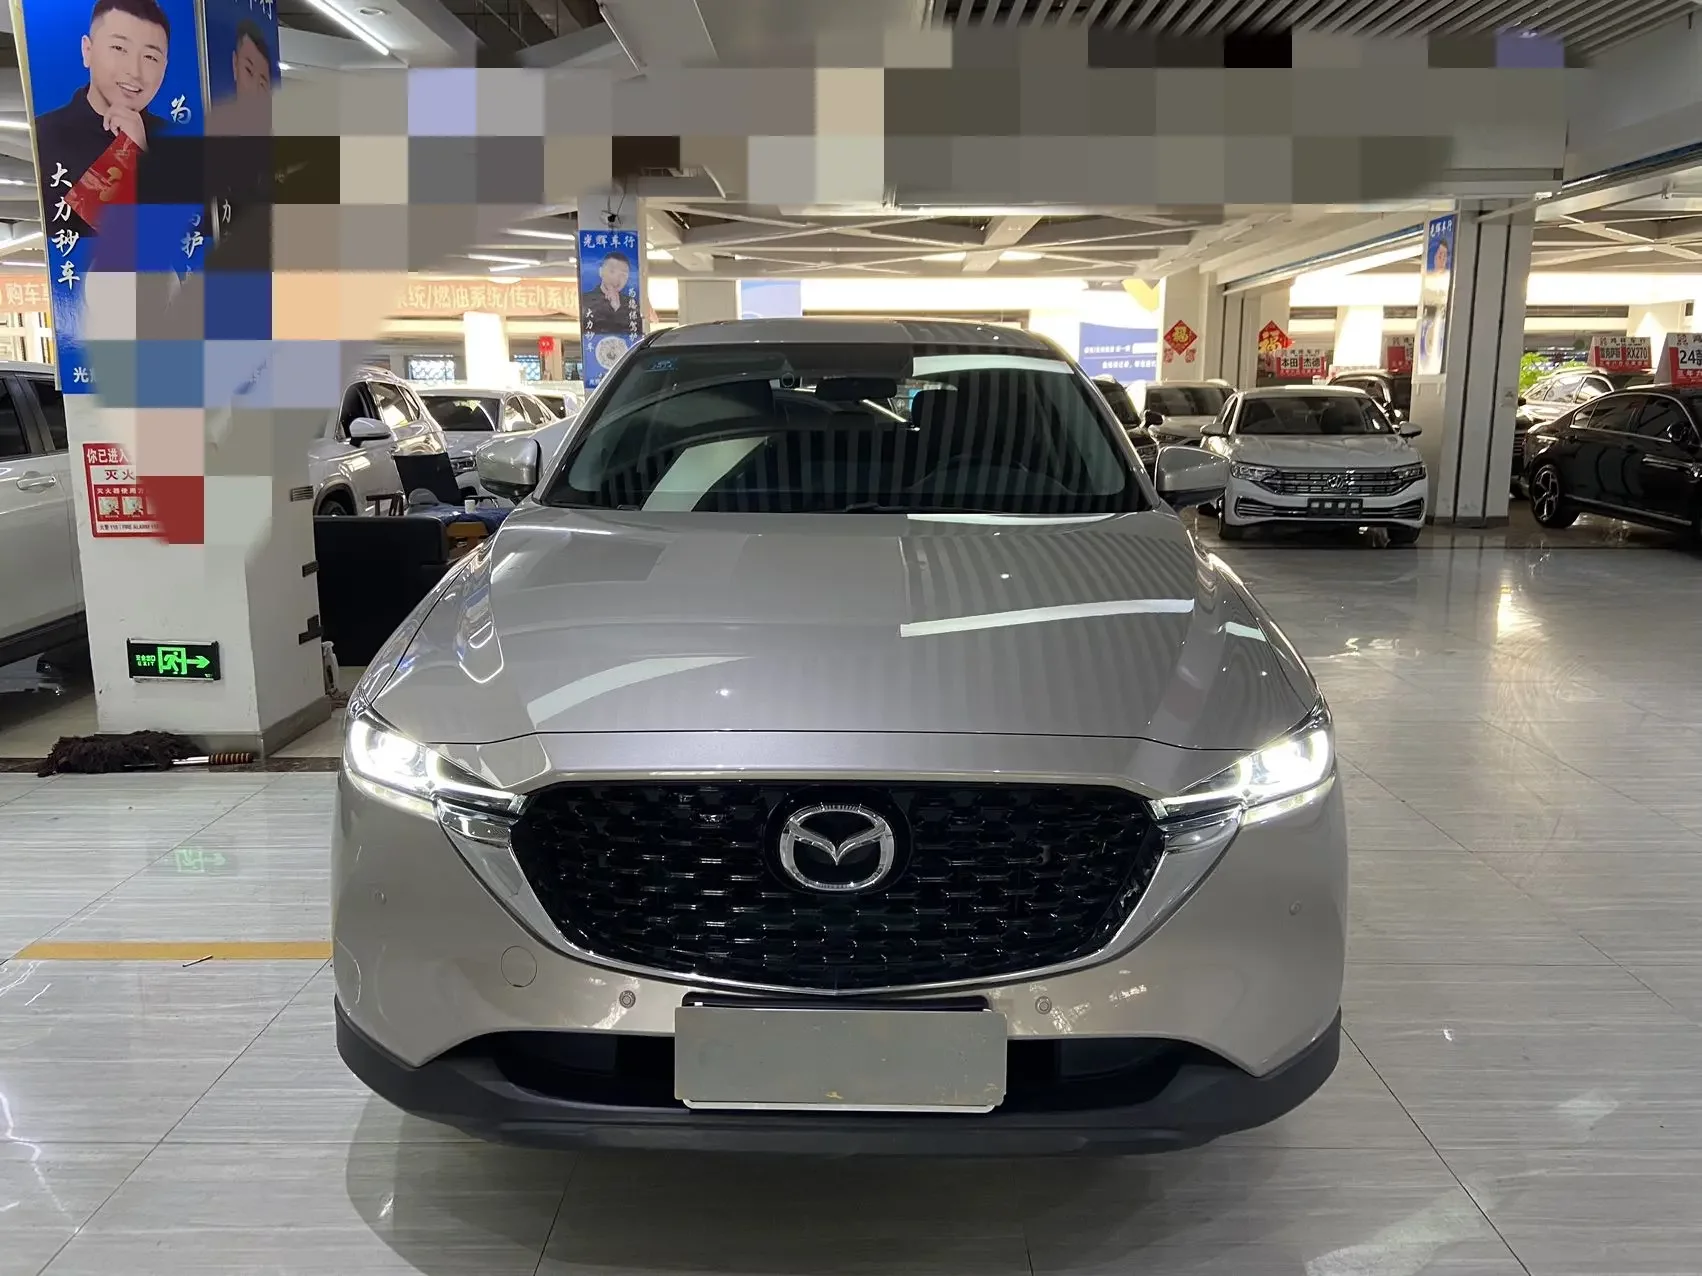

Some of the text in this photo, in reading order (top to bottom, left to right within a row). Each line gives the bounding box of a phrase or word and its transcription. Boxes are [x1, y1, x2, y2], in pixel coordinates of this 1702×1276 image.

[583, 234, 636, 249] 光辉车行
[1281, 357, 1321, 369] 本田 杰德
